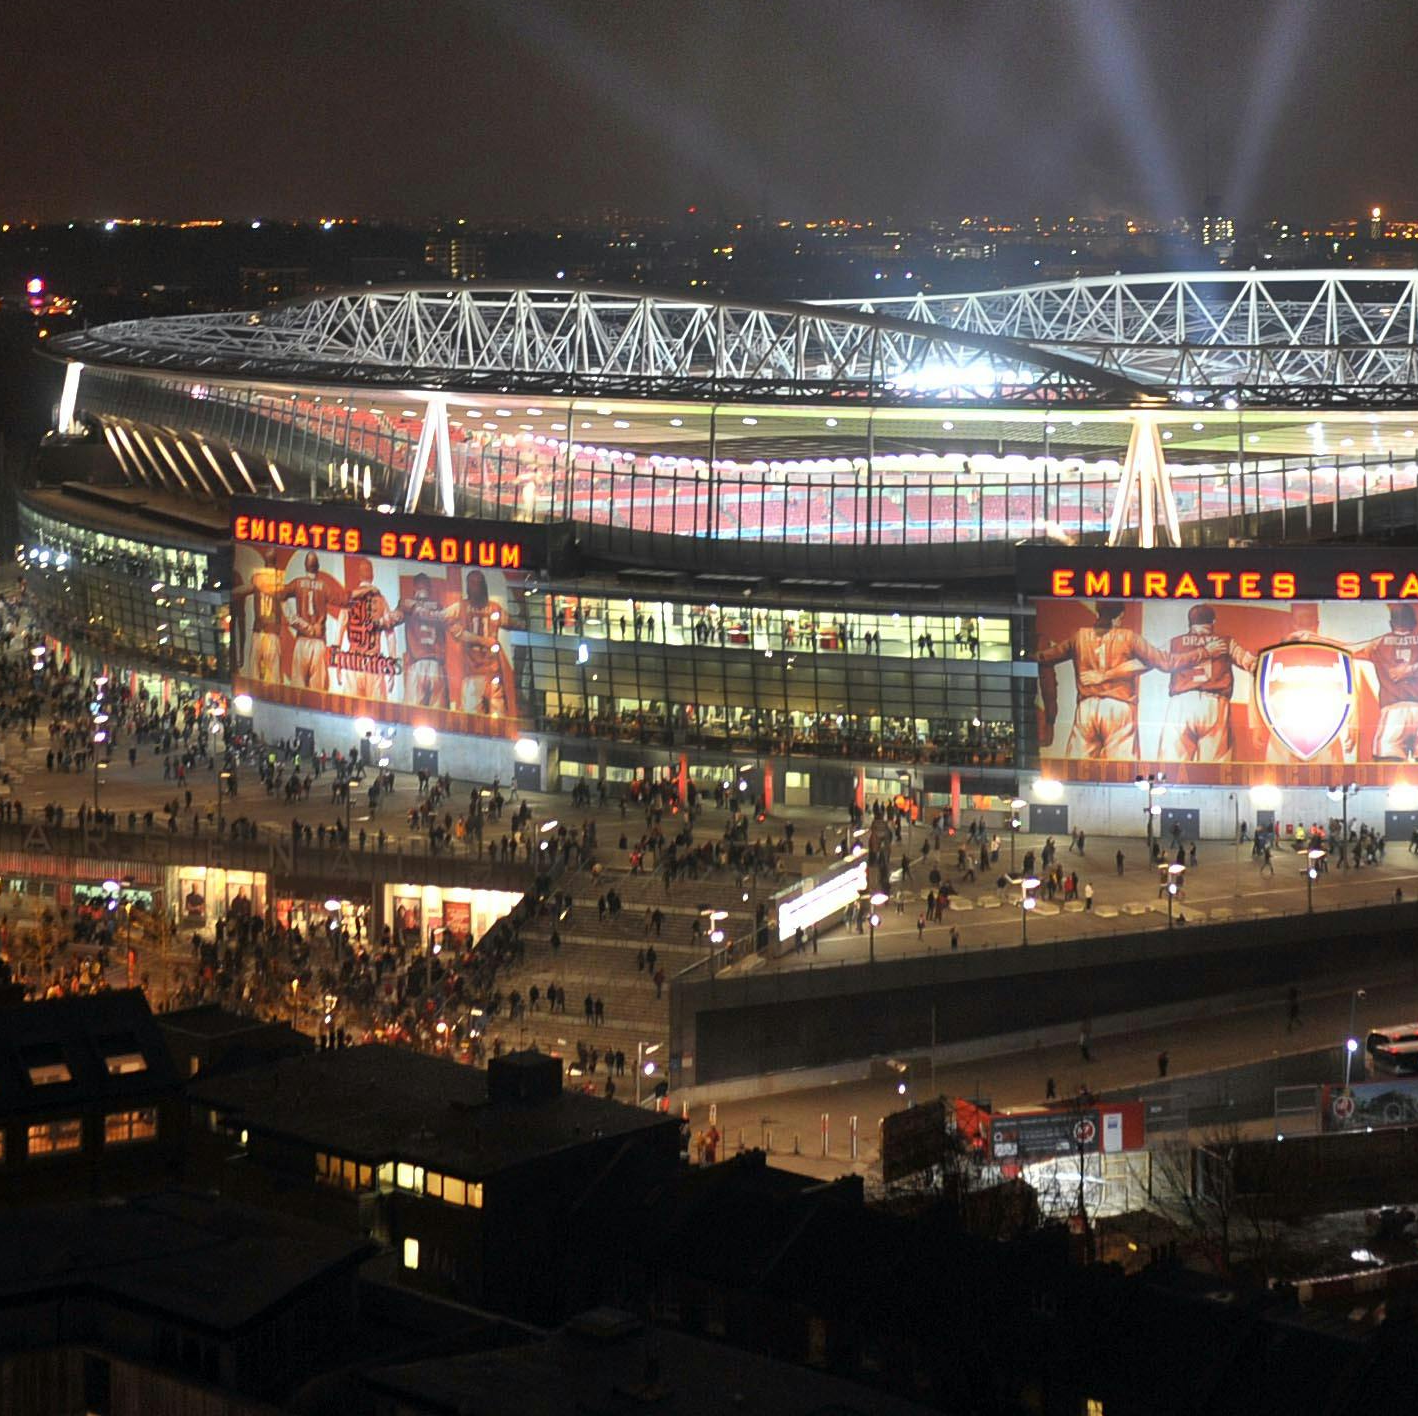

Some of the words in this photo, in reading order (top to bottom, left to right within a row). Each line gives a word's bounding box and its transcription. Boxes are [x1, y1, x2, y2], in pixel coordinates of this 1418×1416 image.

[234, 515, 361, 553] EMIRATES
[380, 532, 521, 569] STADIUM
[1052, 569, 1297, 599] EMIRATES
[1094, 643, 1106, 670] 1
[23, 822, 418, 878] ARSENAL
